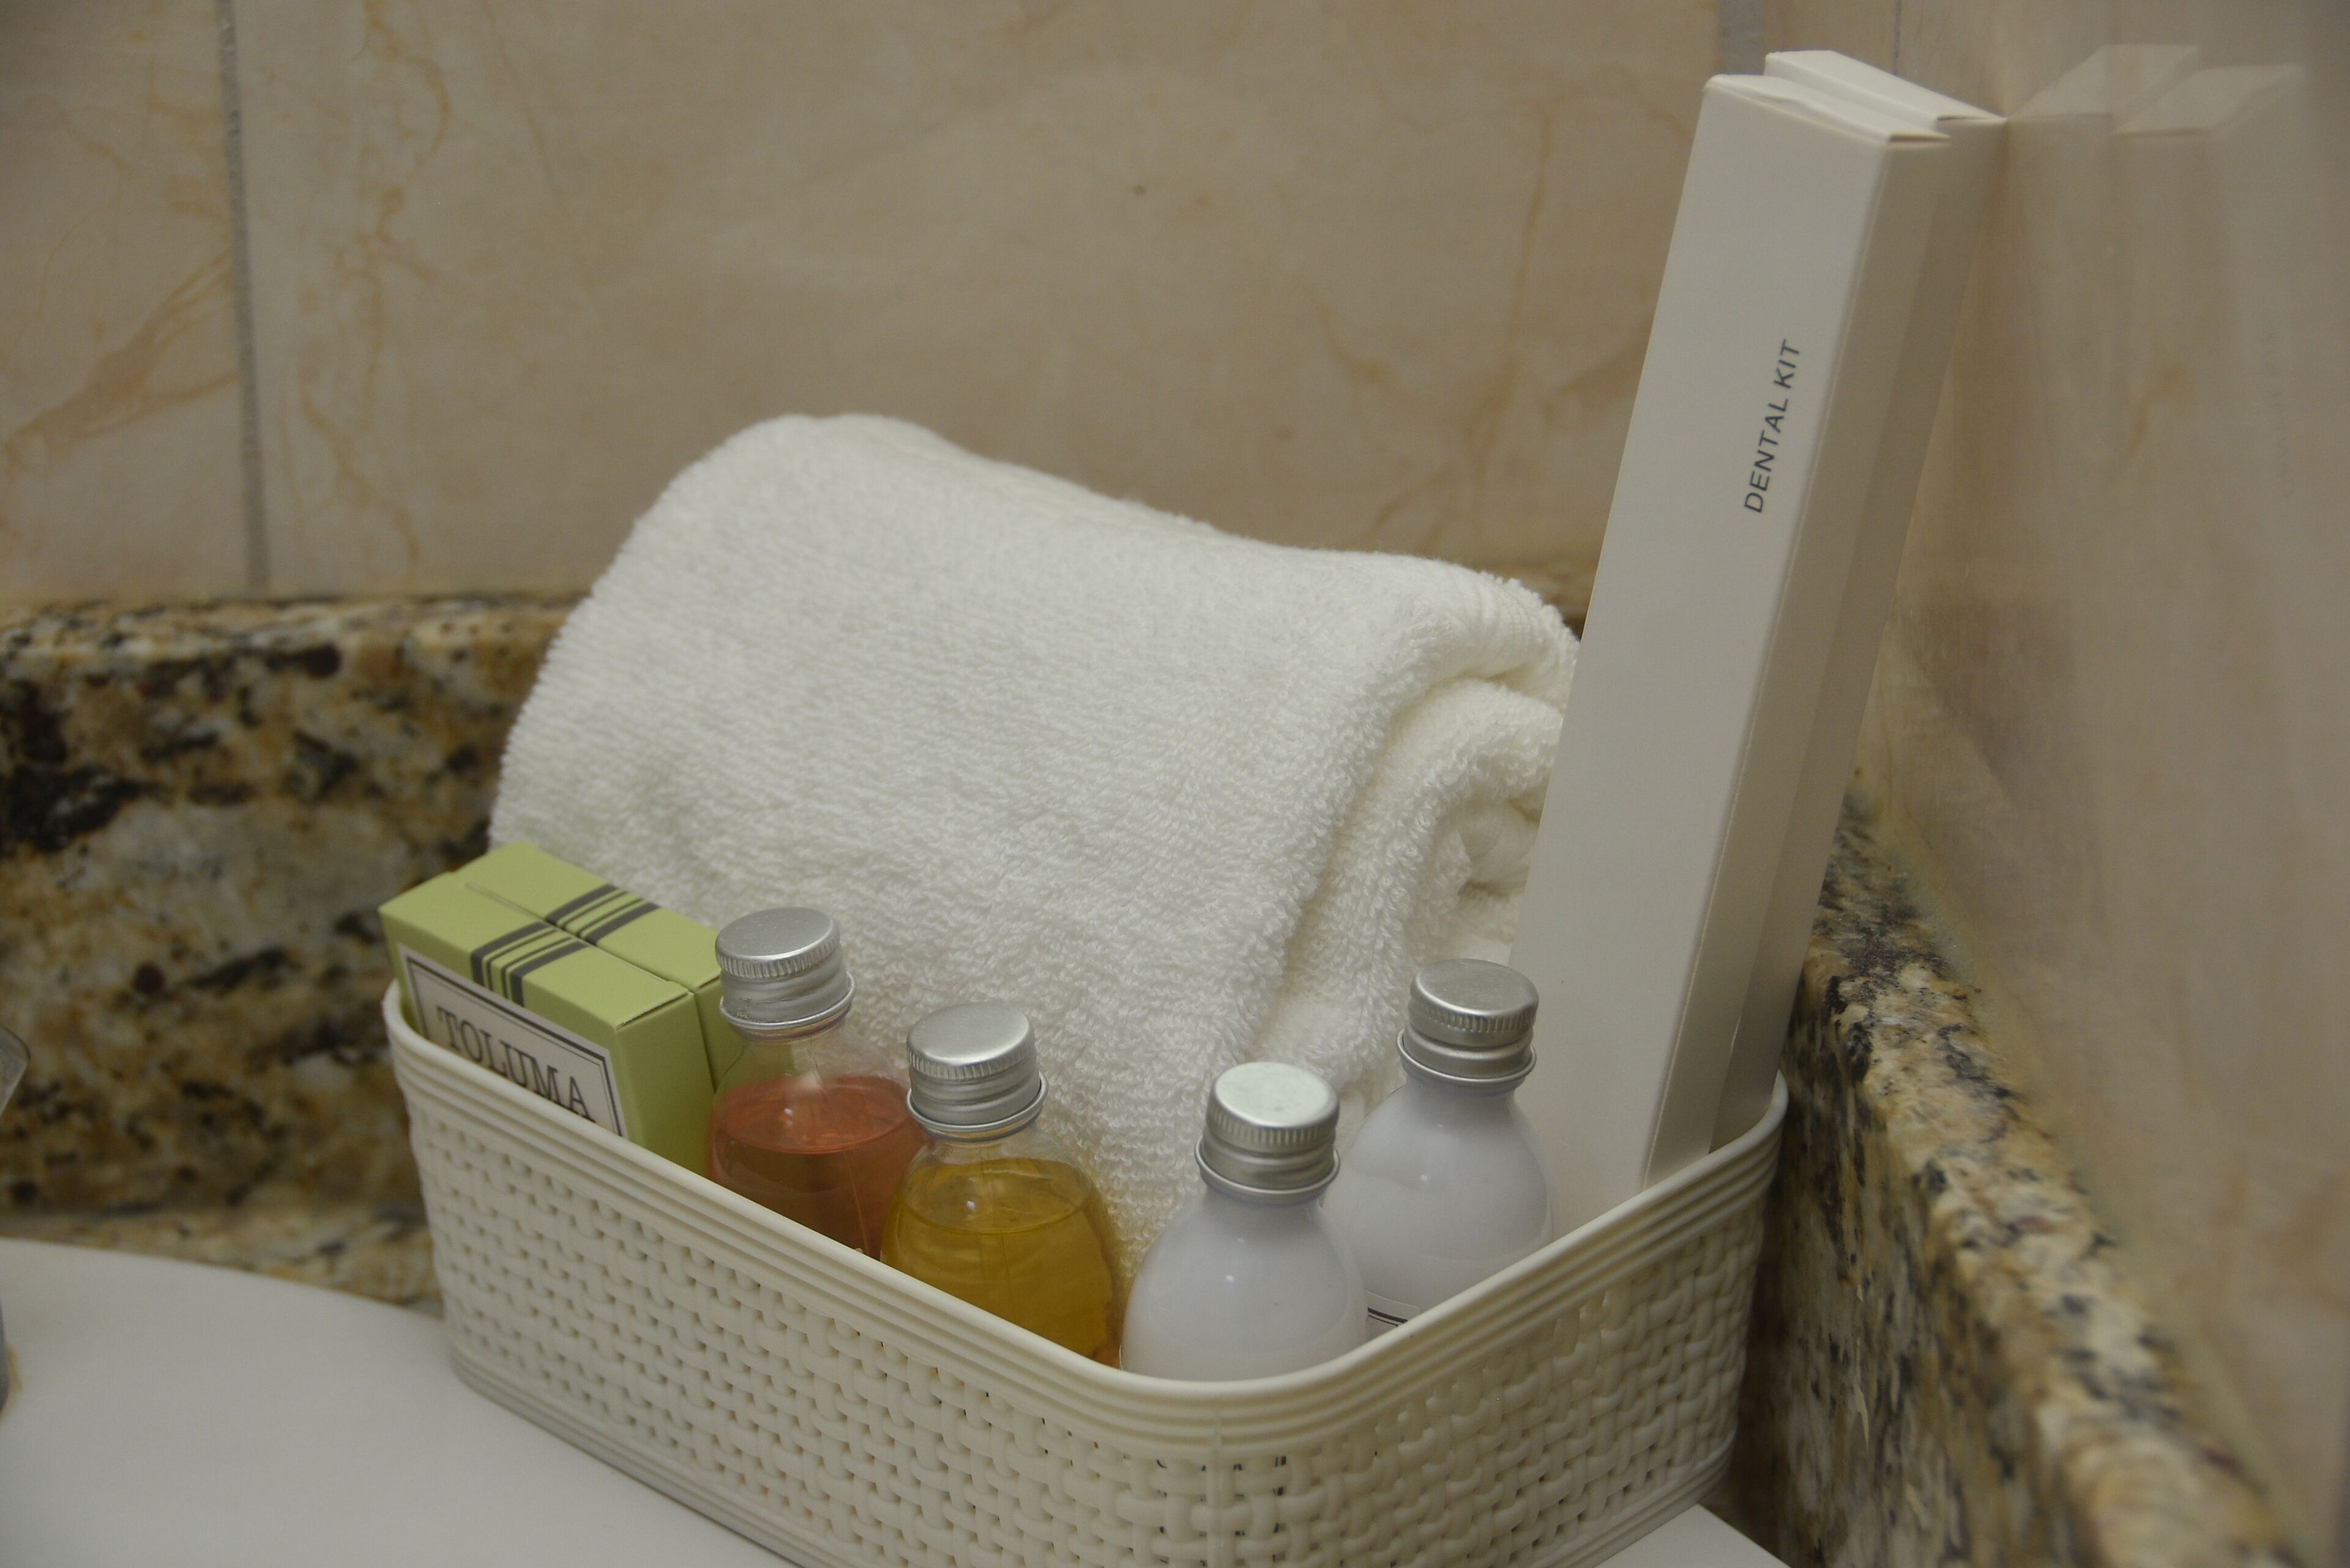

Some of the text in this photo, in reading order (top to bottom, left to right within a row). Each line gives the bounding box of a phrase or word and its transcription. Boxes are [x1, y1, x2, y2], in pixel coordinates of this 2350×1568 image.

[1744, 338, 1800, 513] DENTAL KIT
[436, 1006, 596, 1123] TOLUMA
